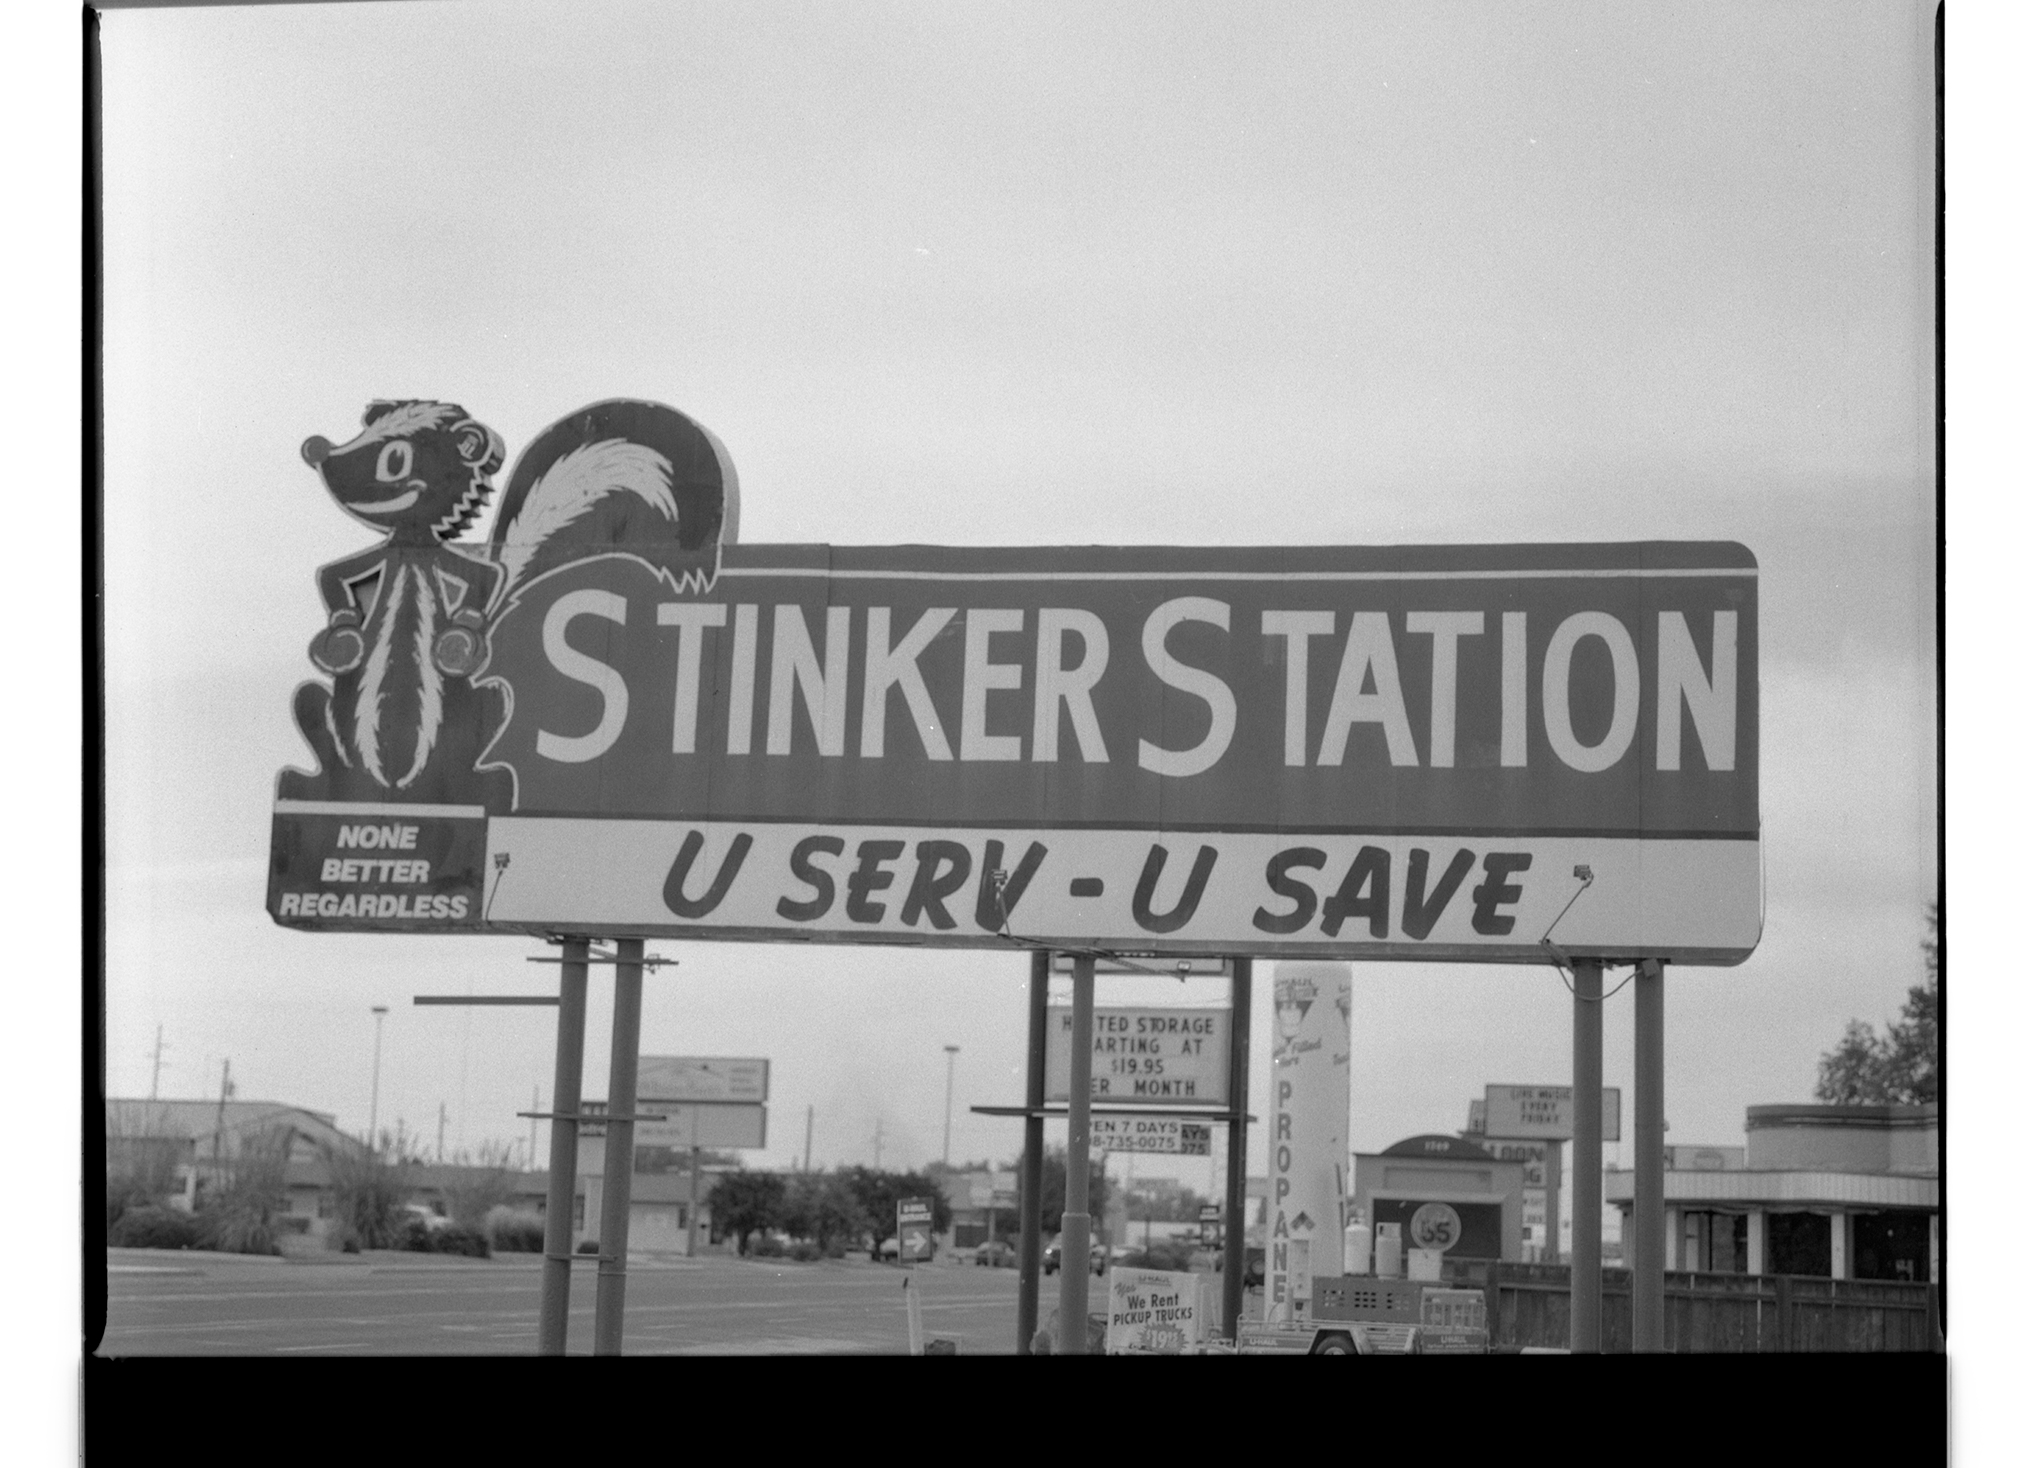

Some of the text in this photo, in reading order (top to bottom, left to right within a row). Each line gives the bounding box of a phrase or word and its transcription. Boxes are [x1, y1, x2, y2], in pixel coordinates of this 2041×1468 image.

[536, 588, 1738, 777] STINKER STATION
[337, 825, 419, 849] NONE
[320, 858, 430, 883] BETTER
[663, 830, 753, 919] U
[776, 835, 1048, 933] SERV
[1132, 843, 1218, 934] U
[1252, 845, 1532, 940] SAVE
[279, 892, 469, 919] REGARDLESS
[1062, 1016, 1214, 1034] HTED STORAGE
[1095, 1037, 1203, 1055] ARTING AT
[1112, 1058, 1164, 1074] $19.95
[1091, 1078, 1196, 1096] ER MONTH
[1091, 1120, 1179, 1134] EN 7 DAYS
[1273, 1080, 1292, 1303] PROPANE
[1127, 1293, 1179, 1310] We Rent
[1113, 1306, 1193, 1326] PICKUP TRUCKS
